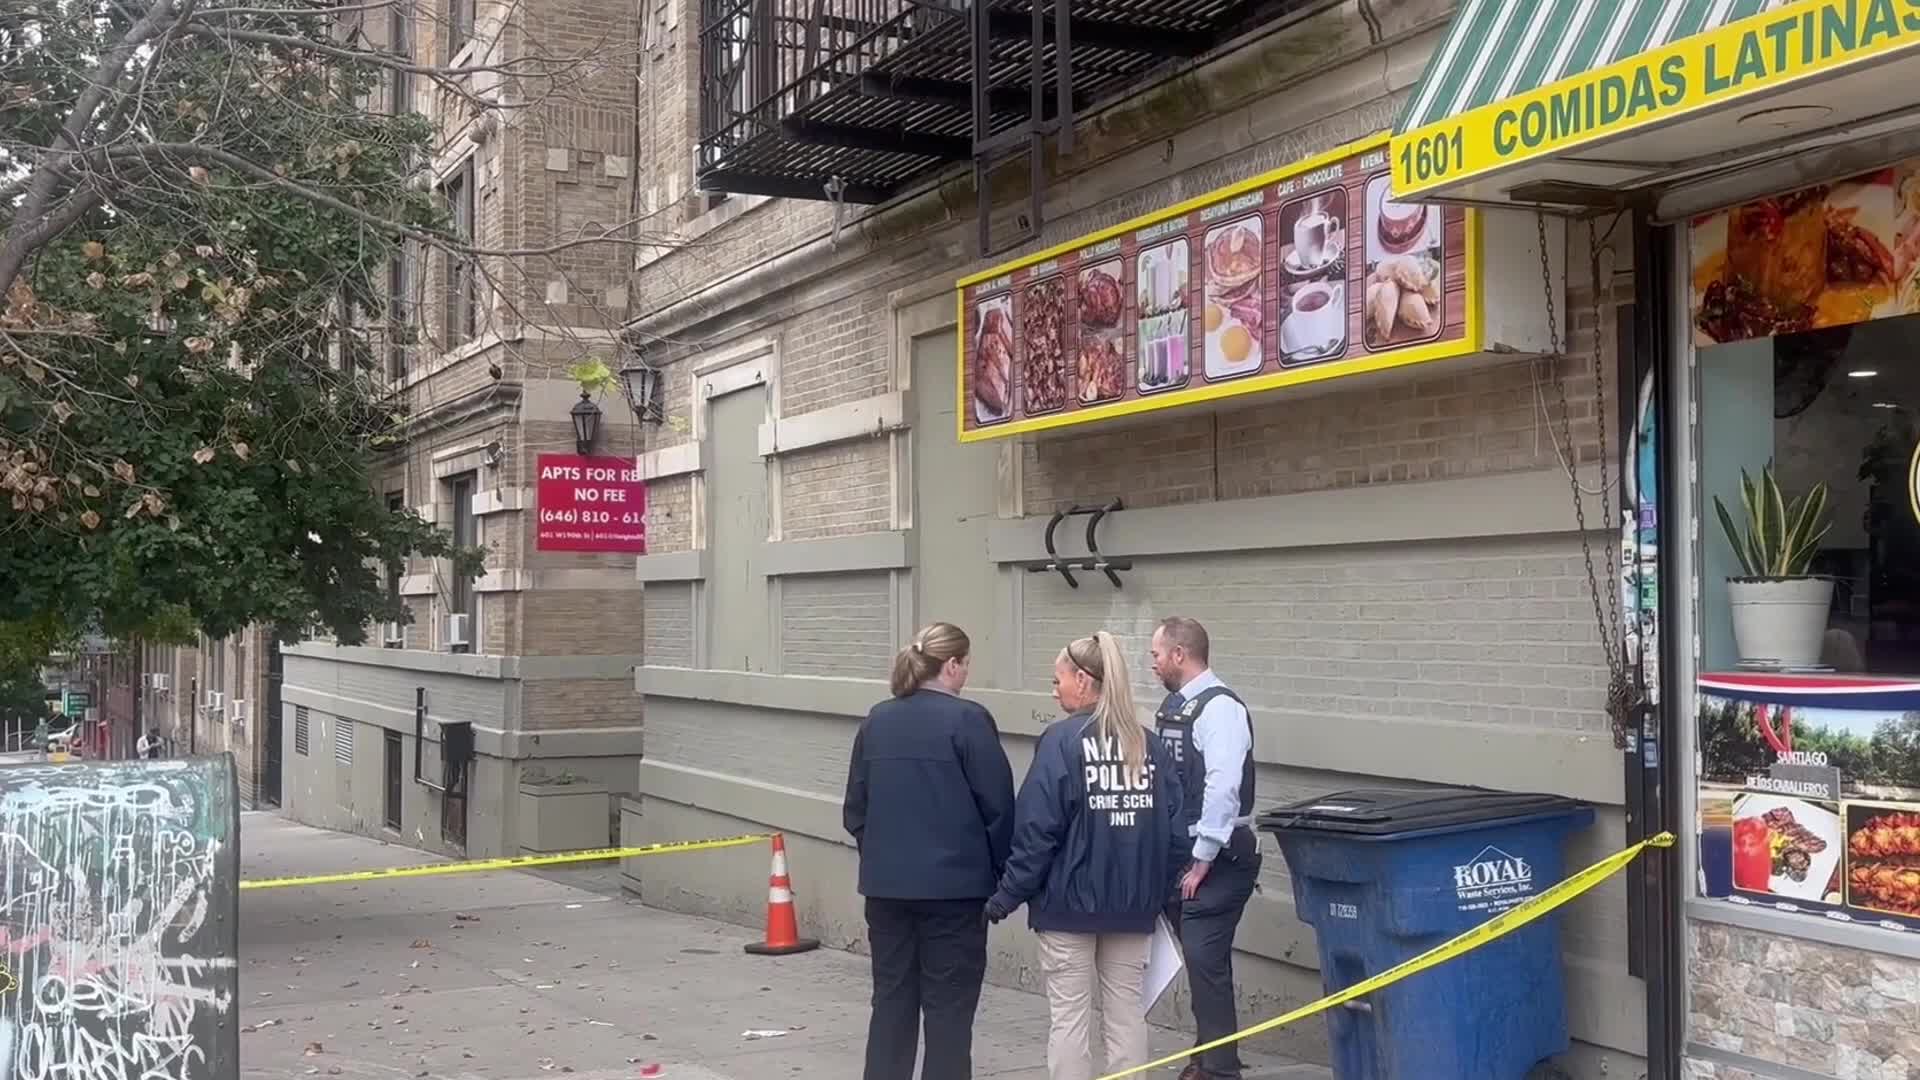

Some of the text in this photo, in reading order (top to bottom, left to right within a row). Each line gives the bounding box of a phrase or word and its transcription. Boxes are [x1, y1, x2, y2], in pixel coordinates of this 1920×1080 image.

[1400, 126, 1463, 184] 1601
[1493, 55, 1686, 156] COMIDAS
[541, 466, 581, 480] APTS
[586, 468, 616, 481] FOR
[574, 487, 626, 502] NO FEE
[541, 508, 578, 524] (646)
[582, 511, 610, 523] 810
[1776, 752, 1828, 766] SANTIAGO
[1453, 857, 1532, 887] ROYAL
